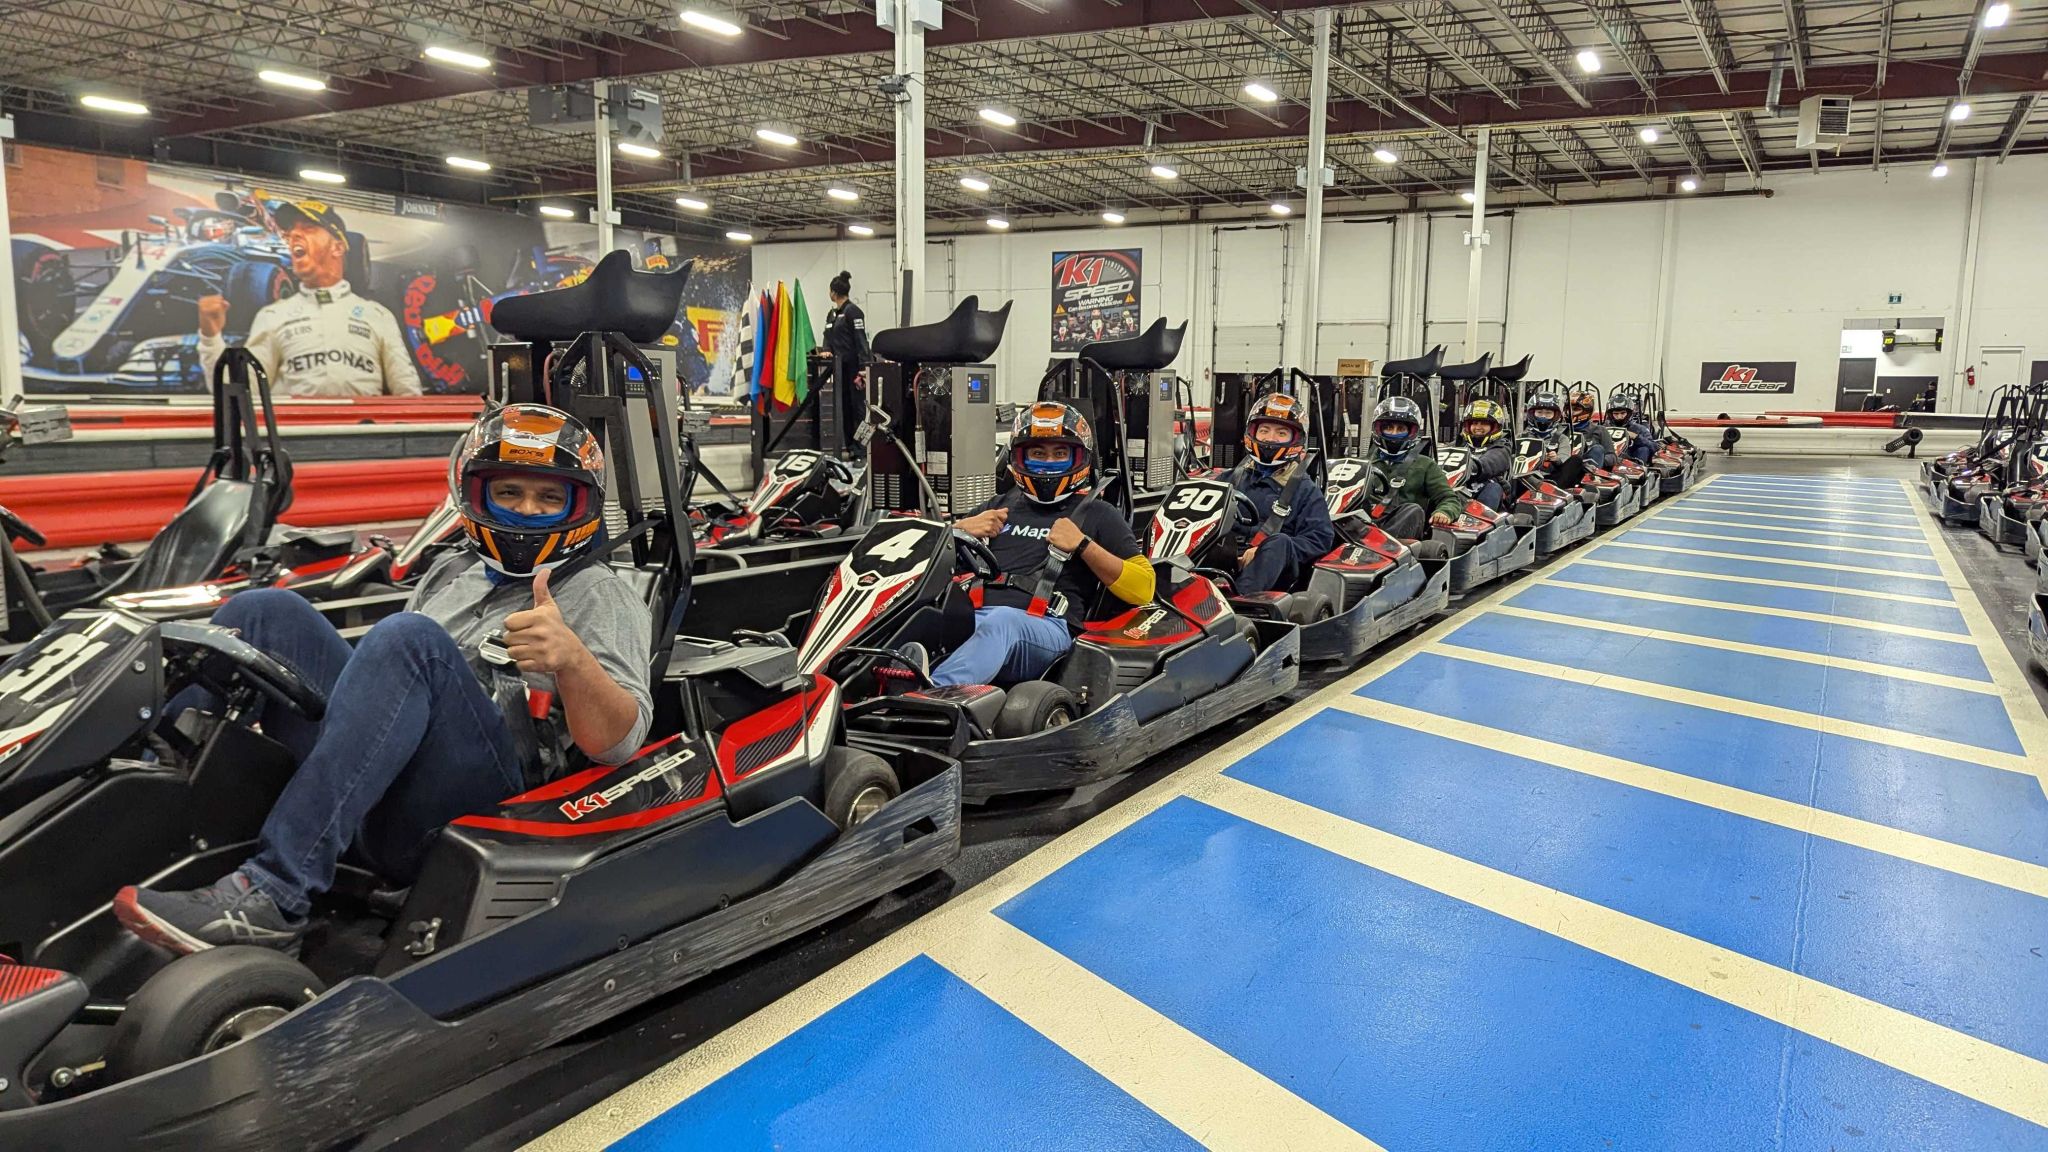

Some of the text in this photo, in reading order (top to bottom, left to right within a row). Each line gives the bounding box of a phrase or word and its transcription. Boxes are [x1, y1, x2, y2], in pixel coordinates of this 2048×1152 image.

[1059, 254, 1106, 287] K1
[1063, 280, 1134, 302] SPEED
[1078, 295, 1114, 307] WARNING
[1720, 365, 1758, 384] K1
[1707, 380, 1787, 391] RaceGear
[776, 454, 818, 472] 16
[1437, 451, 1466, 467] 22
[1168, 488, 1223, 511] 30
[865, 528, 928, 562] 4
[0, 633, 110, 702] 31
